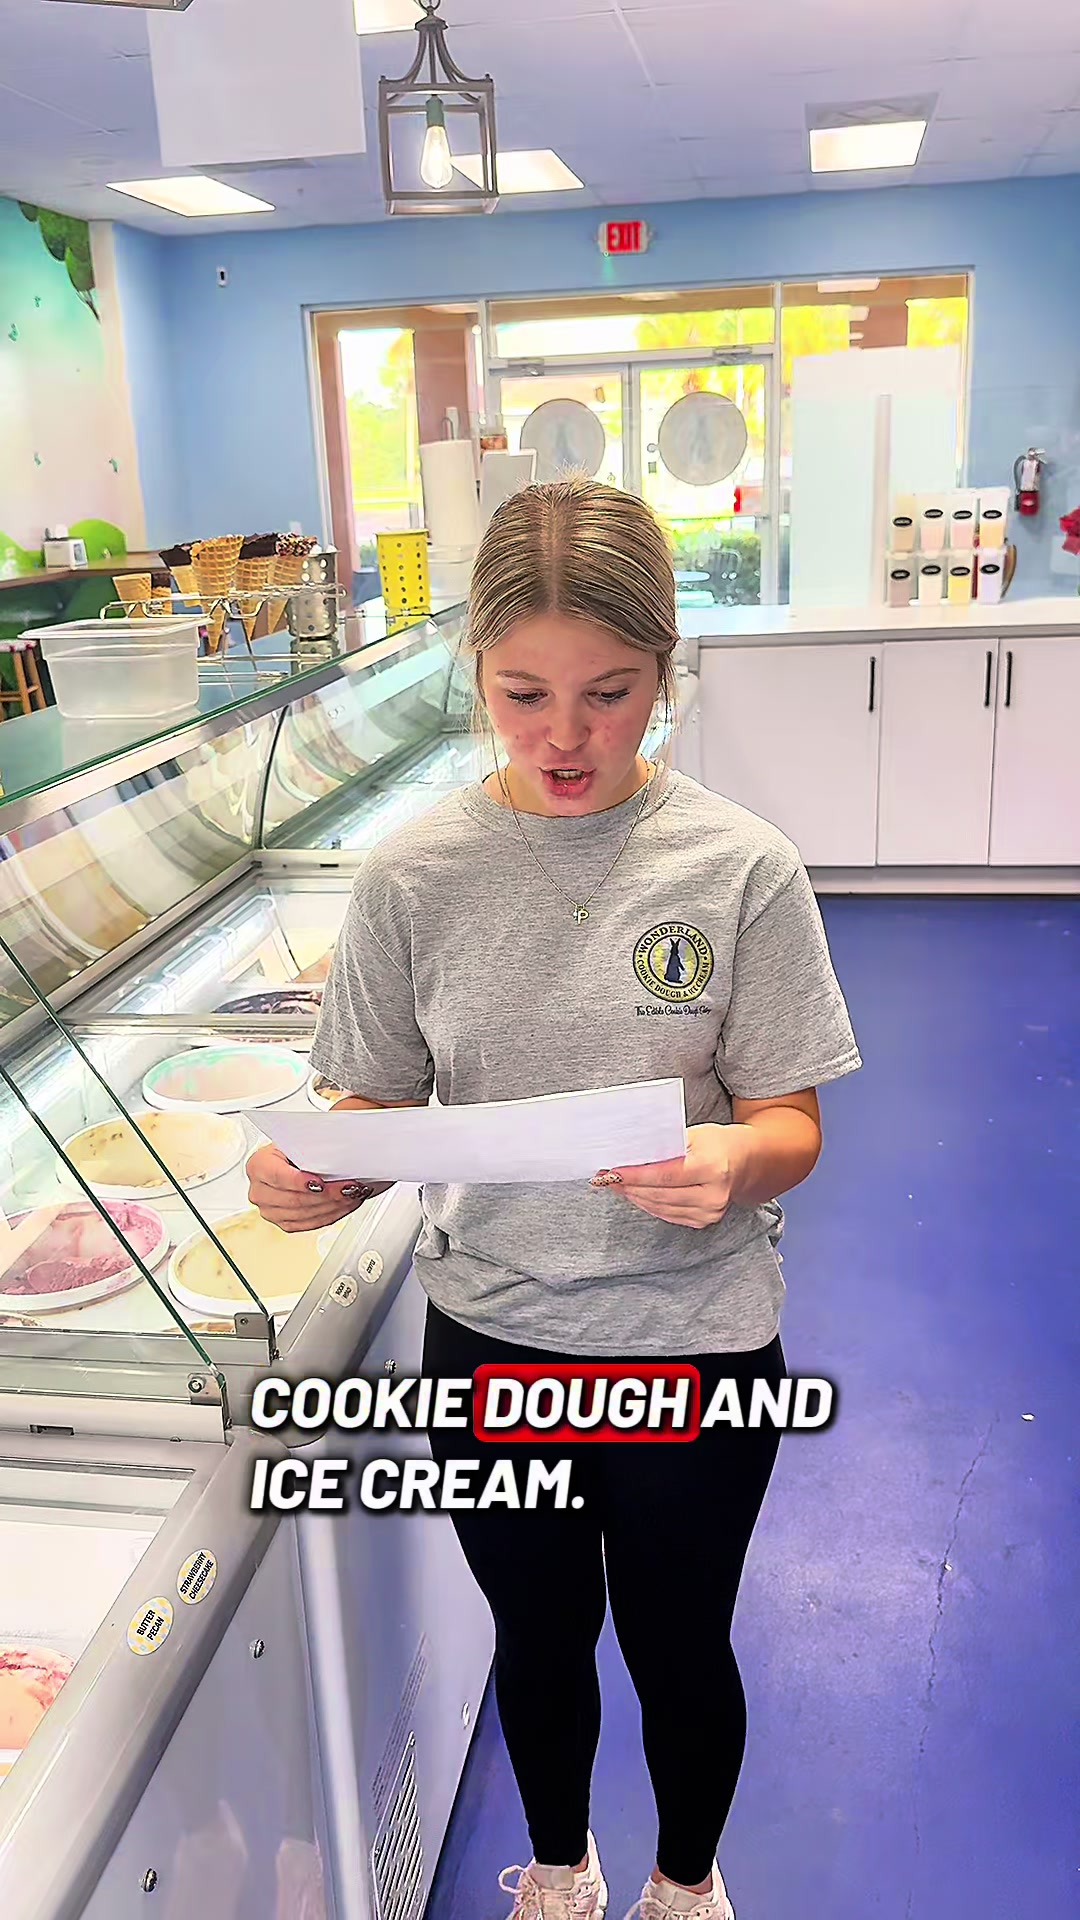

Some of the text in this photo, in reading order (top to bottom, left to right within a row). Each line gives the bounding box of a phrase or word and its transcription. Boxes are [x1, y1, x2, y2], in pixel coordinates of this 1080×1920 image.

[607, 221, 641, 252] EXIT
[638, 925, 708, 956] WONDERLAND
[636, 959, 655, 988] COOKIE
[654, 984, 682, 999] DOUGH
[696, 962, 710, 990] CREAM
[180, 1551, 207, 1594] STRAWBERRY
[188, 1559, 214, 1600] CHEESECAKE
[136, 1609, 156, 1635] BUTTER
[146, 1616, 165, 1641] PECAN
